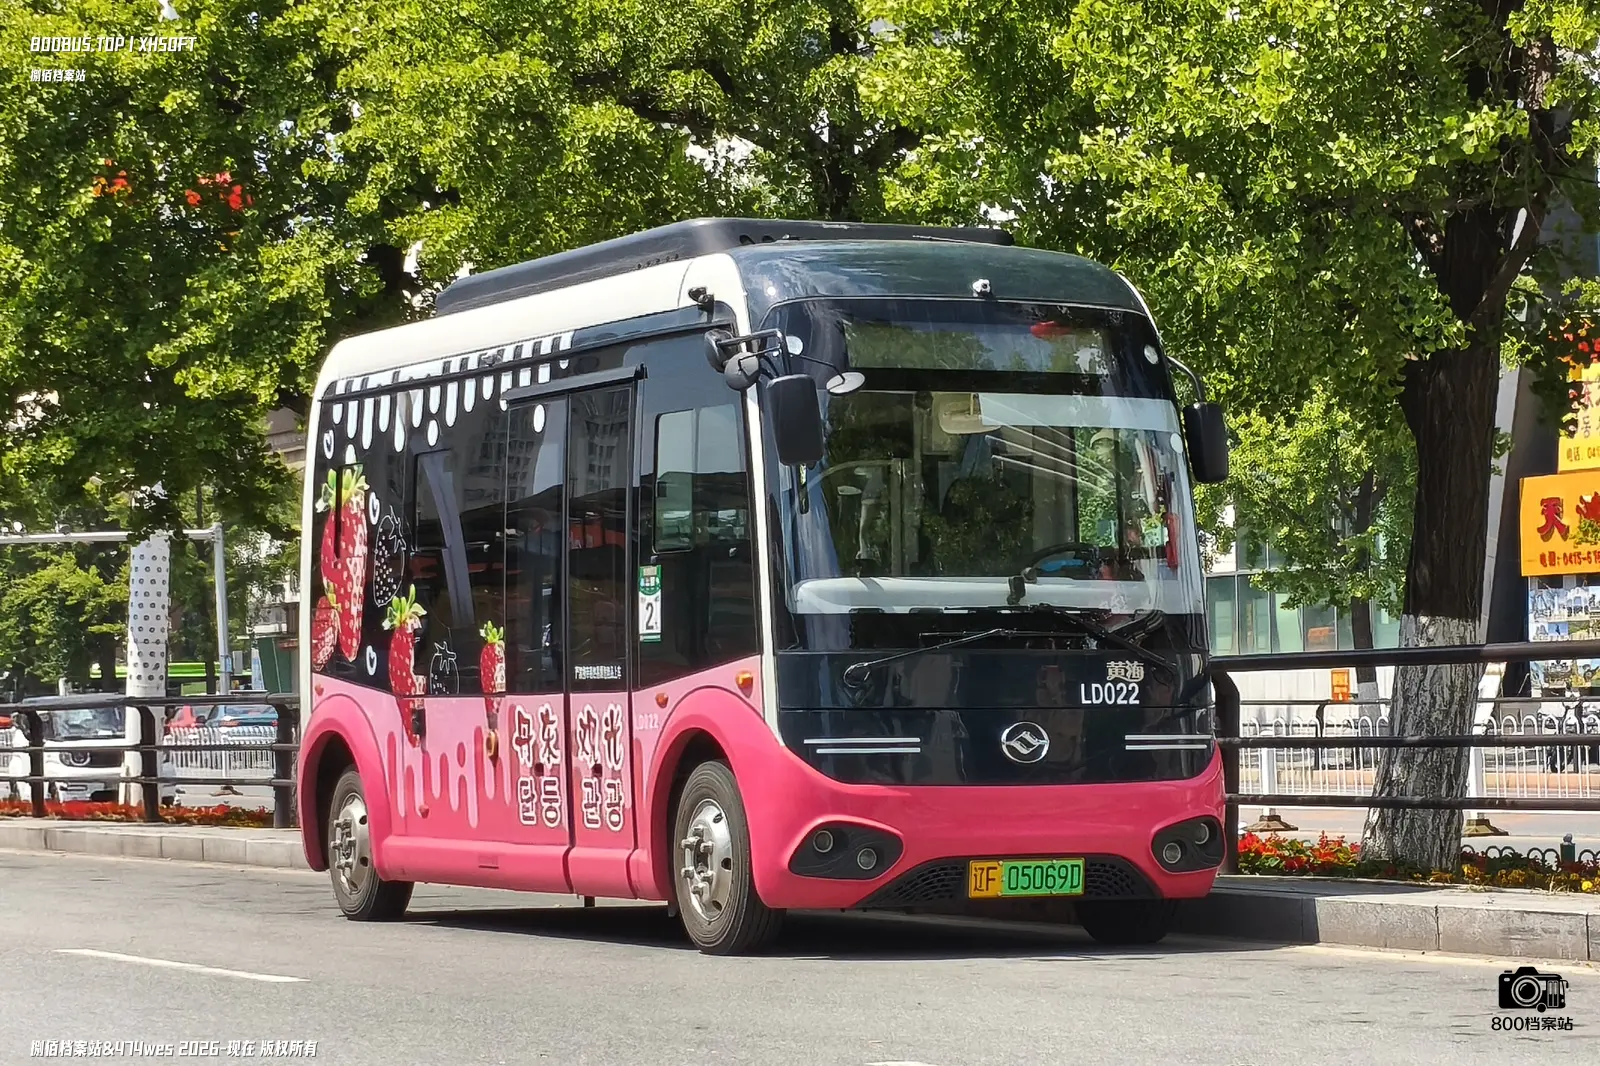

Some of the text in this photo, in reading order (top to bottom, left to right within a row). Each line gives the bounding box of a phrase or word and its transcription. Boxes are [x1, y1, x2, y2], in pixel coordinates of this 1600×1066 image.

[645, 602, 654, 630] 2
[1106, 660, 1144, 682] 黄海
[1080, 682, 1140, 705] LD022
[1008, 864, 1082, 891] 05069D
